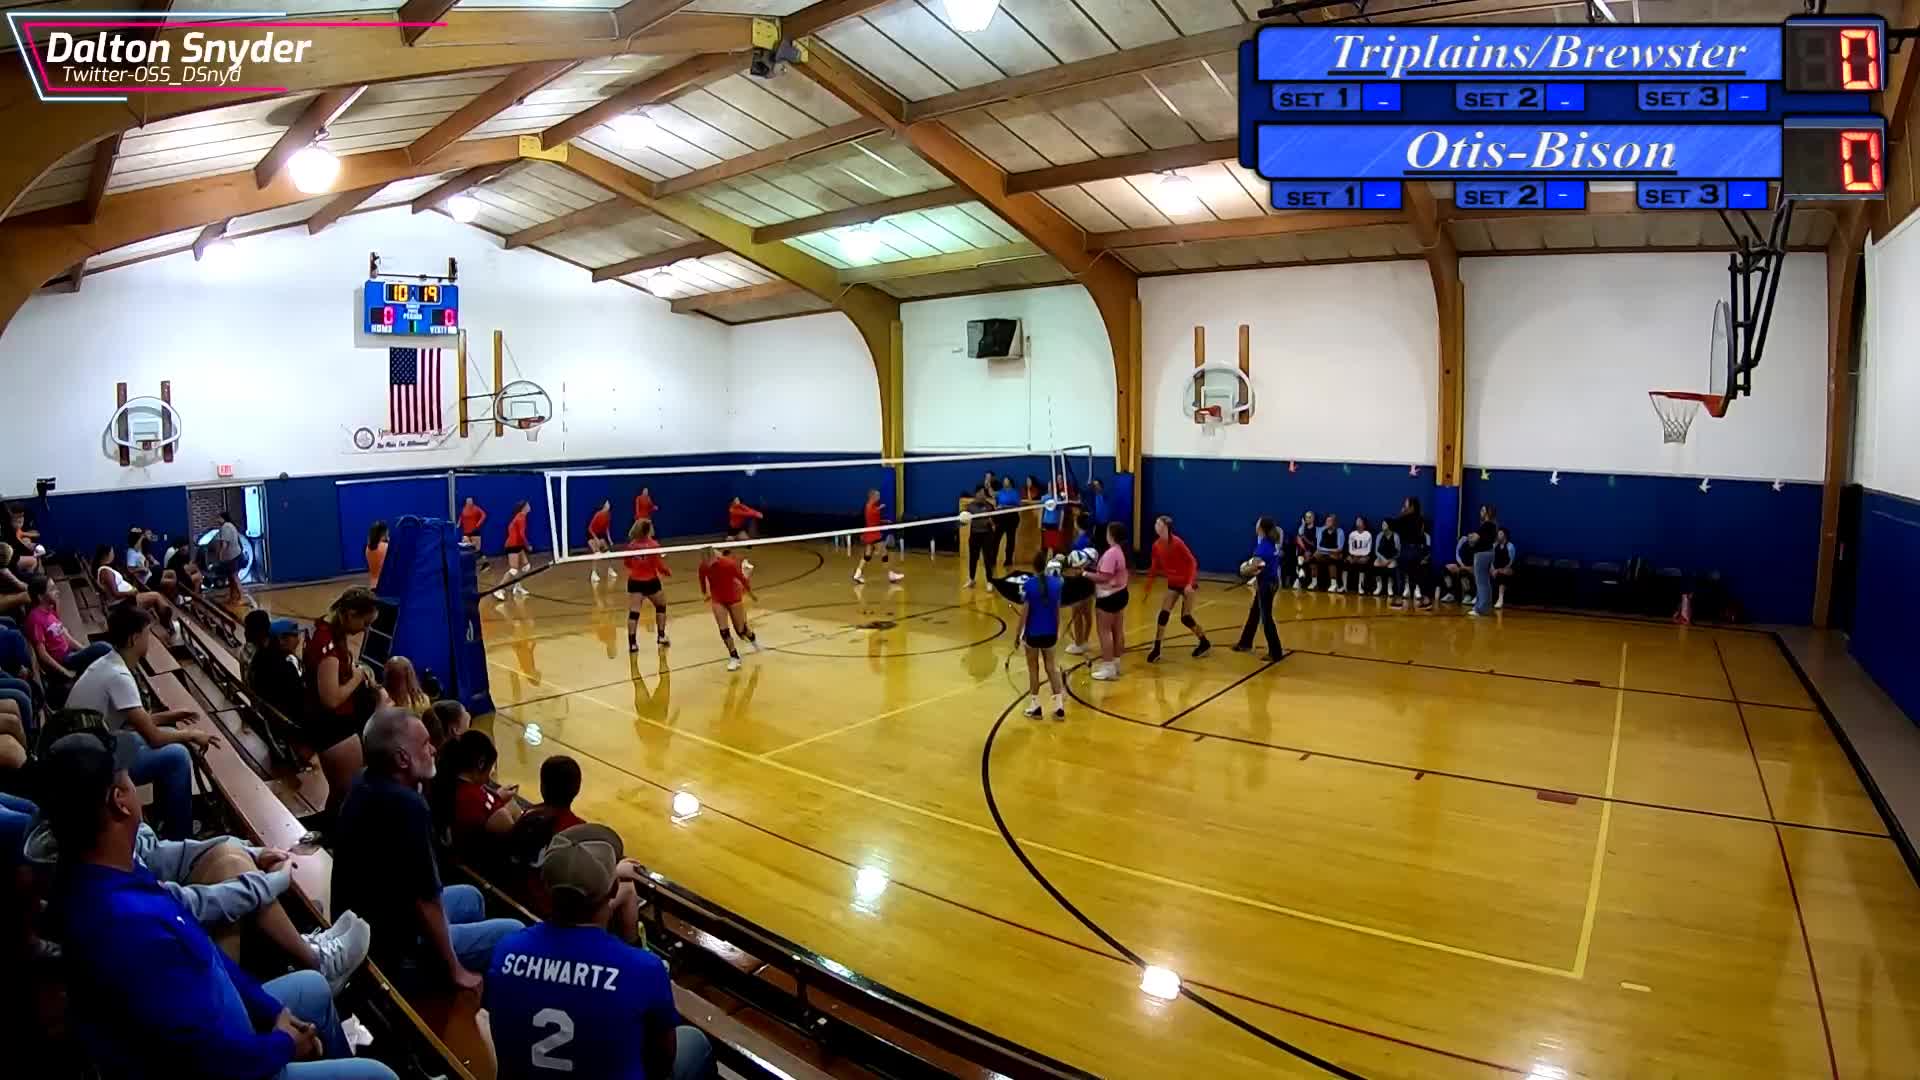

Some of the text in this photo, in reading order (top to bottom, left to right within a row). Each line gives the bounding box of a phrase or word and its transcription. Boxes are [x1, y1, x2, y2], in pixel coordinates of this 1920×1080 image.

[383, 306, 394, 325] 0
[445, 308, 455, 326] 0
[502, 953, 620, 991] SCHWARTZ
[531, 1008, 575, 1071] 2
